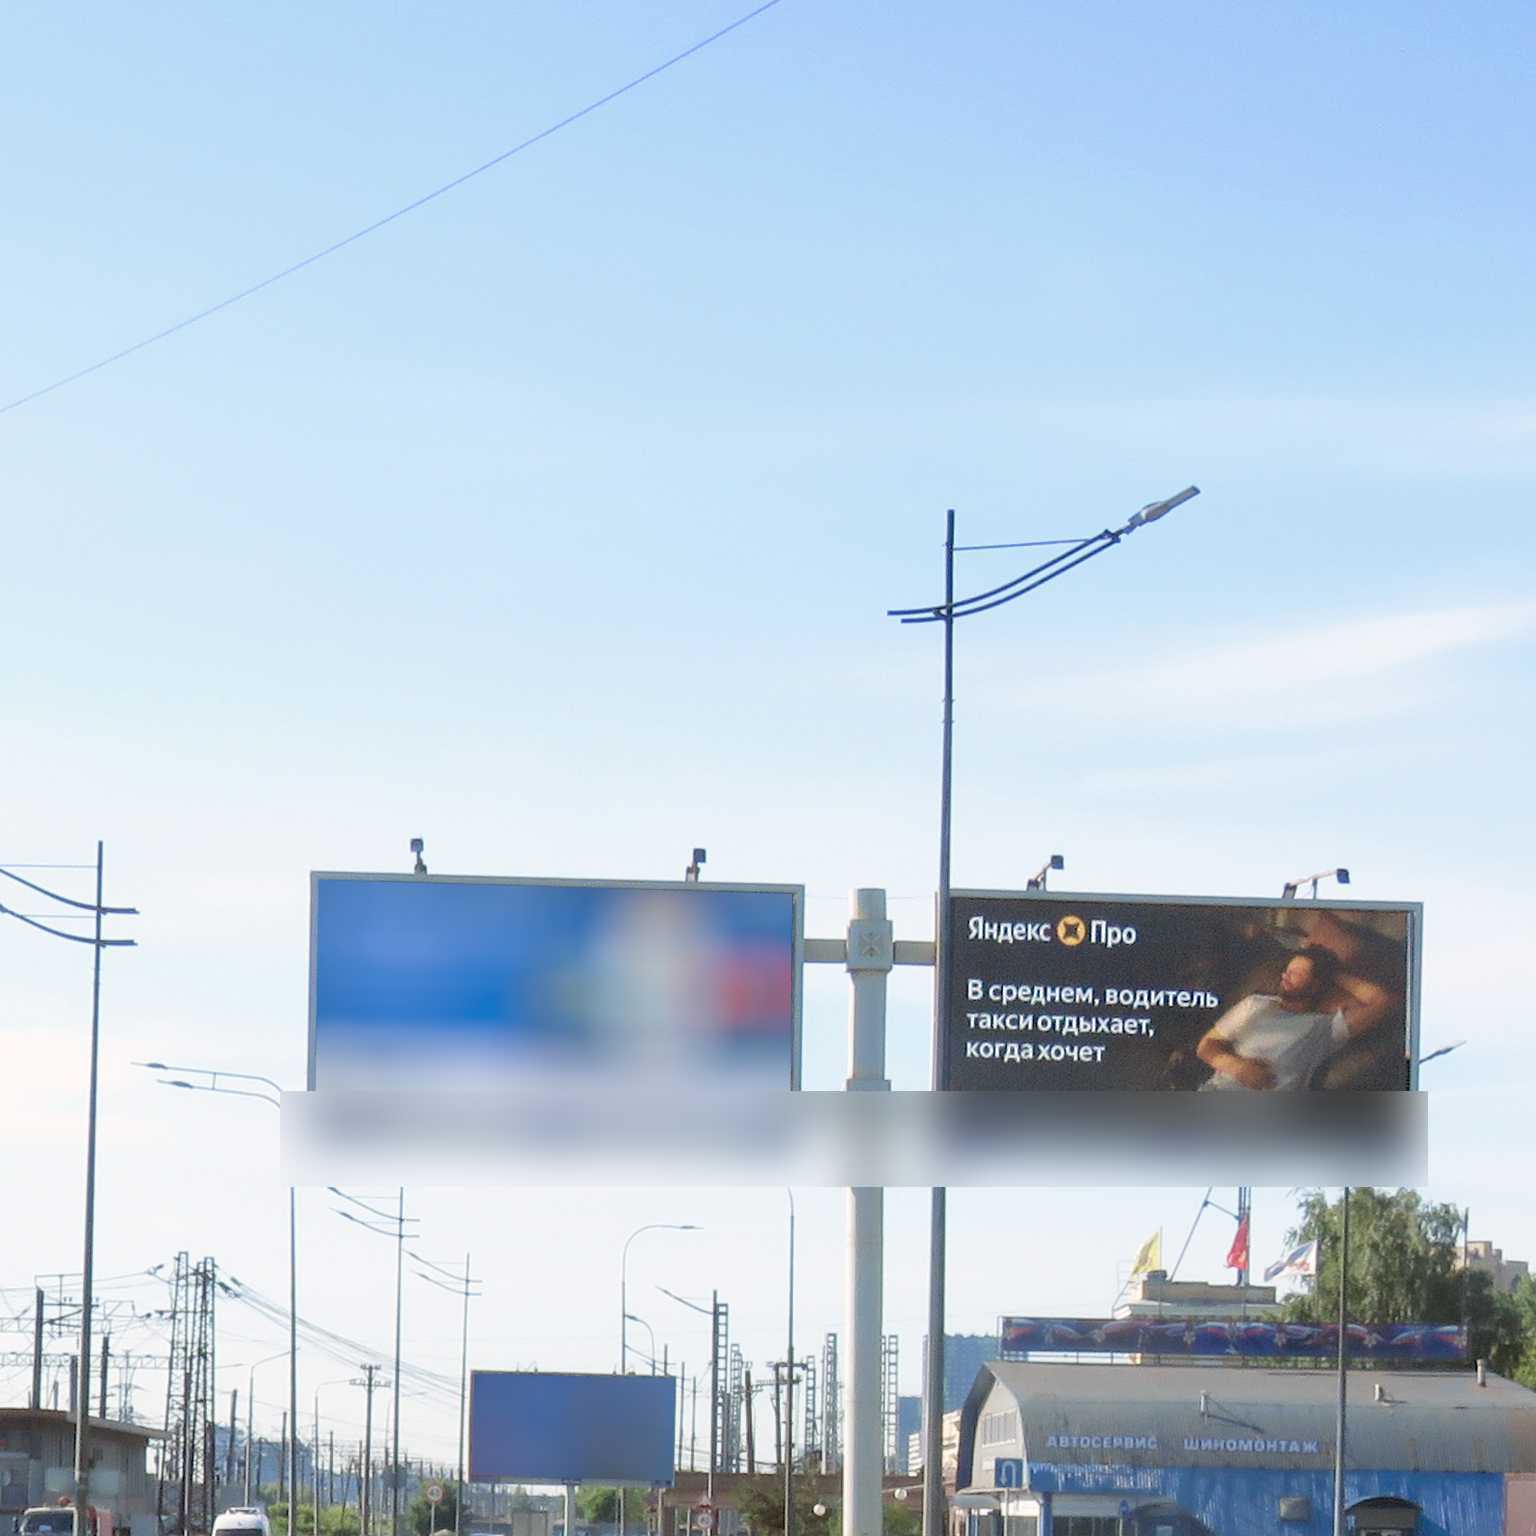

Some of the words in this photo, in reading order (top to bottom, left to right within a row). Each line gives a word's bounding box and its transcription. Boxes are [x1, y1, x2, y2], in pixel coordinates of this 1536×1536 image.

[968, 915, 1052, 944] Яндекс
[1090, 919, 1137, 948] Про
[967, 979, 983, 1000] В
[989, 982, 1100, 1007] среднем,
[1105, 987, 1219, 1009] водитель
[966, 1011, 1033, 1030] такси
[1038, 1013, 1155, 1038] отдыхает,
[966, 1041, 1033, 1063] когда
[1038, 1043, 1106, 1062] хочет
[1046, 1435, 1158, 1449] АВТОСЕРВИС
[1183, 1438, 1318, 1453] ШИНОМОНТАЖ
